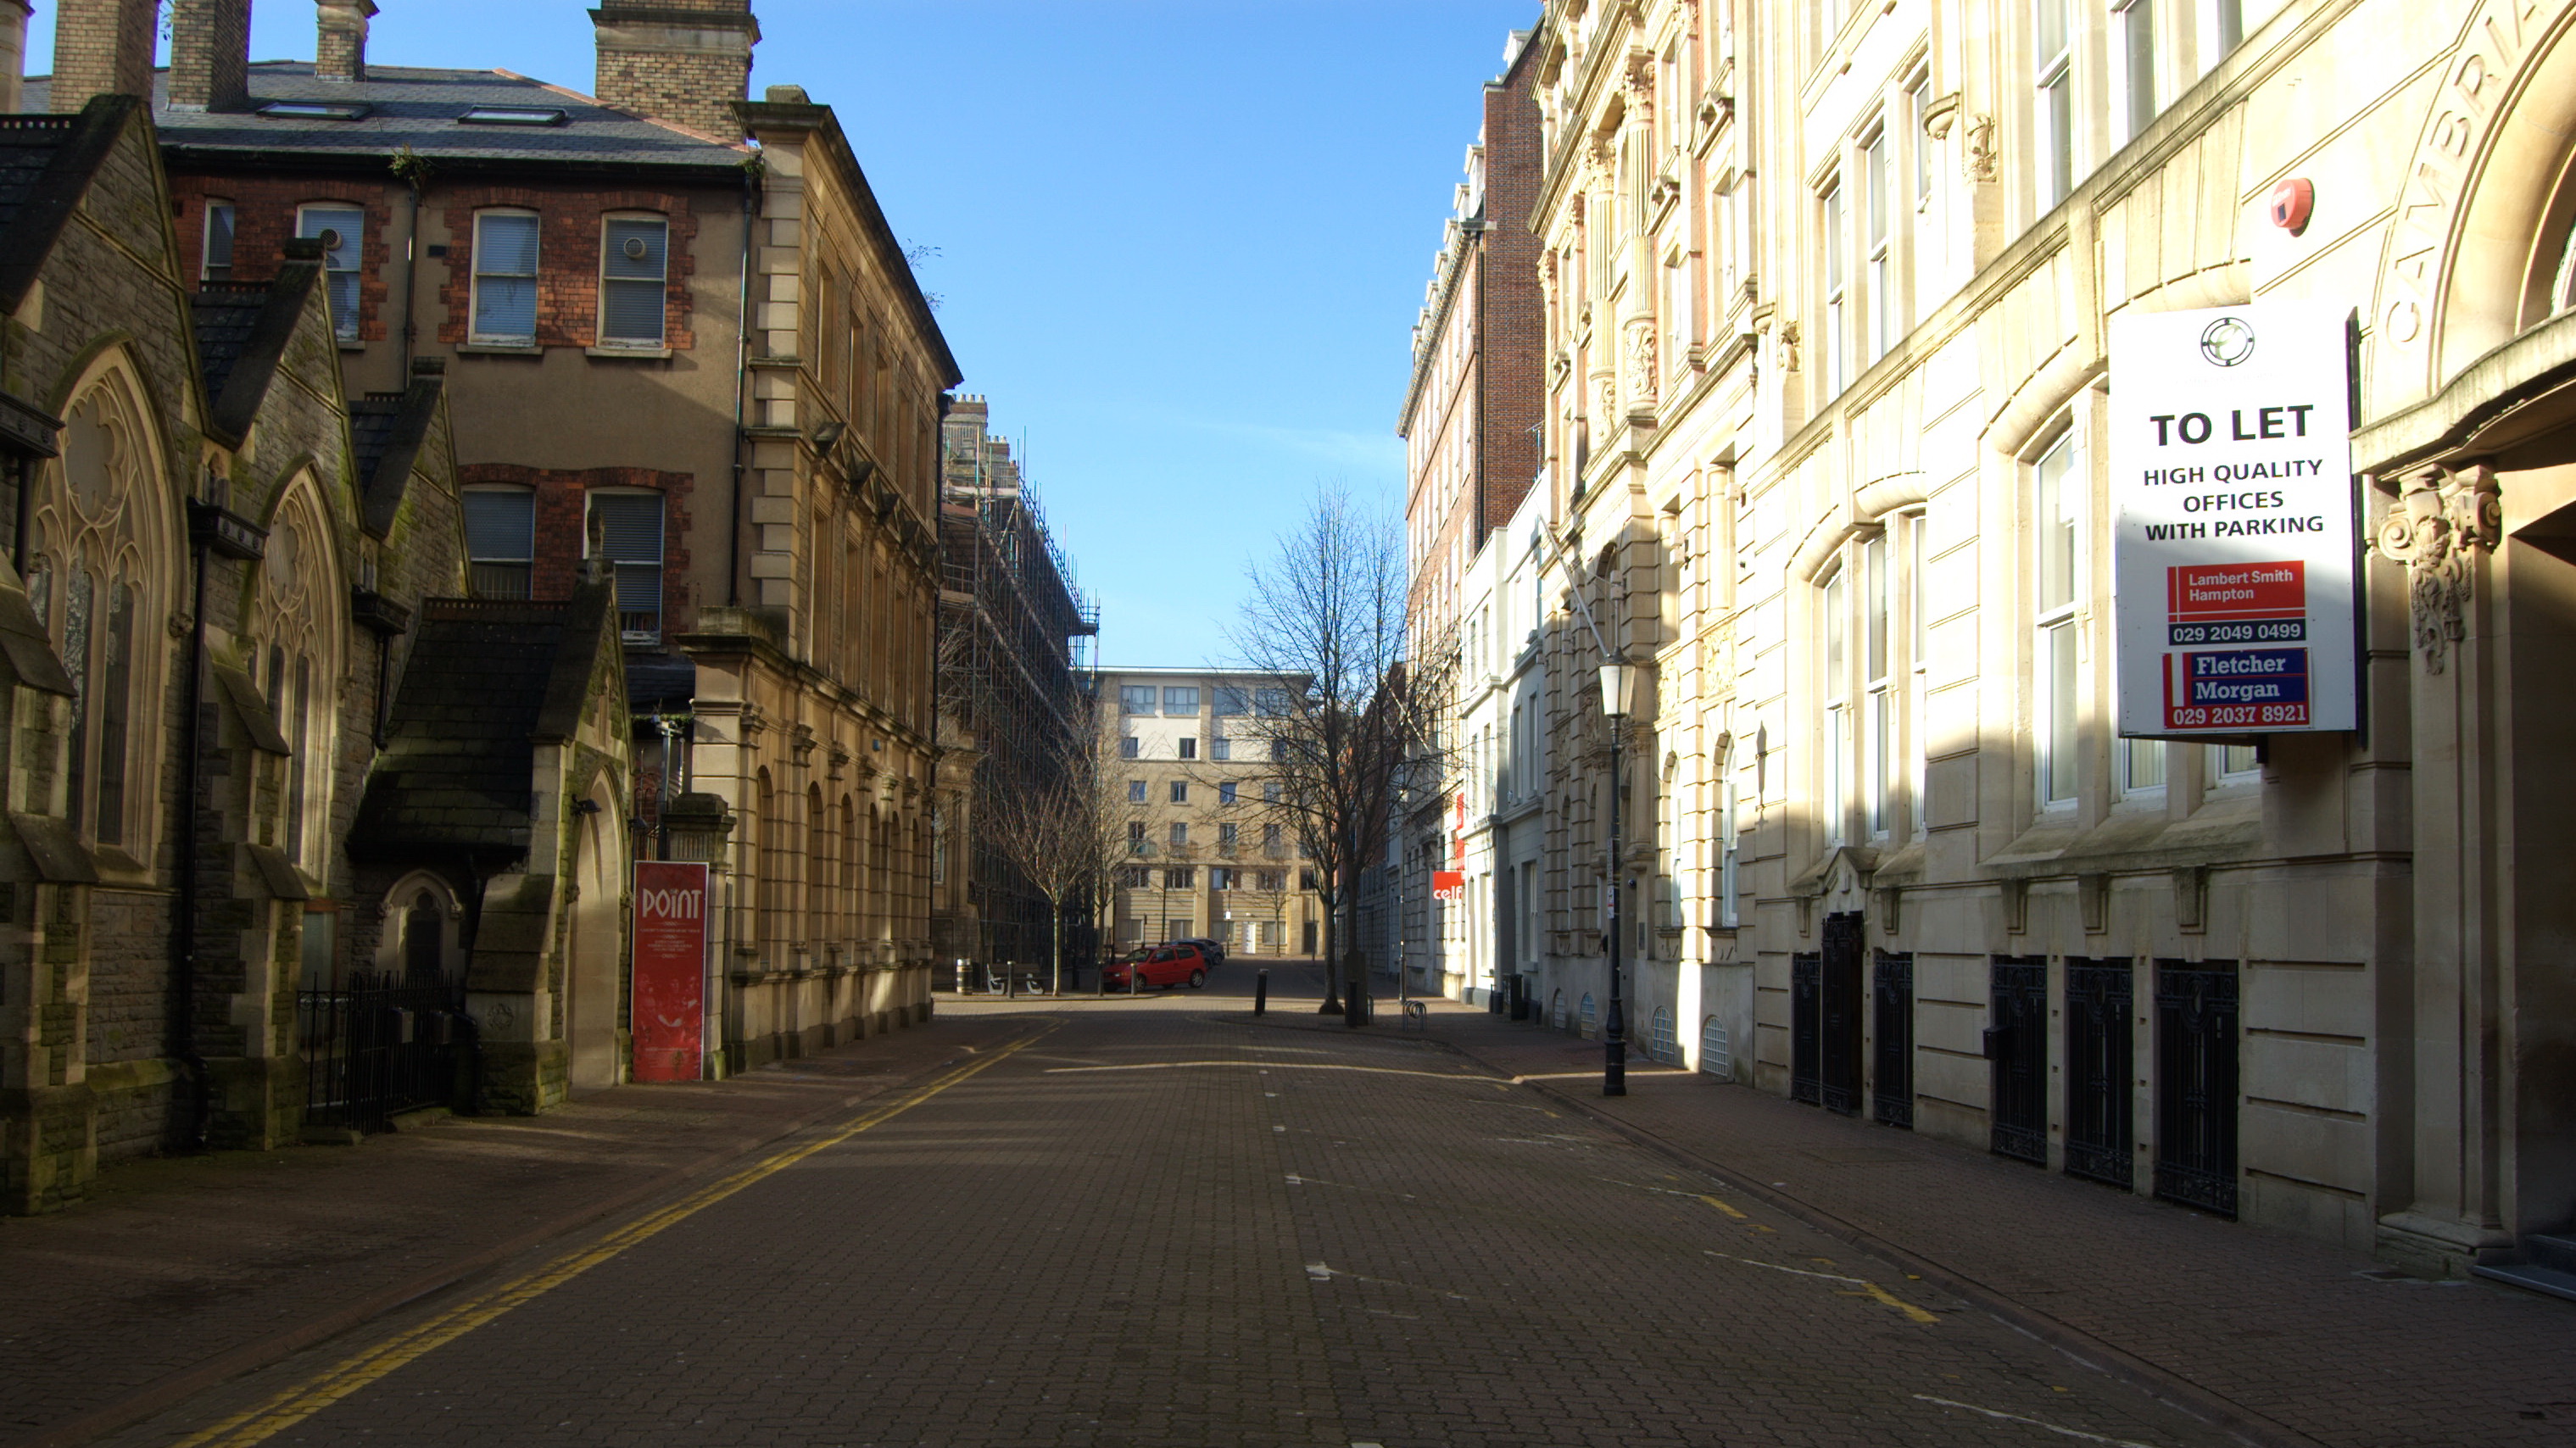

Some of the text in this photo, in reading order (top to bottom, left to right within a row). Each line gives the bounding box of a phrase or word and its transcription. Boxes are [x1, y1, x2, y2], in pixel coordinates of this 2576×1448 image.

[2149, 404, 2314, 447] TO LET
[2144, 459, 2323, 486] HIGH QUALITY
[2183, 491, 2283, 513] OFFICES
[2144, 515, 2323, 541] WITH PARKING
[2188, 569, 2294, 586] Lambert Smith
[2189, 588, 2255, 603] Hampton
[2173, 623, 2301, 643] 029 2049 0499
[2196, 654, 2287, 675] Fletcher
[2195, 682, 2280, 702] Morgan
[2172, 705, 2306, 726] 029 2037 8921
[1433, 885, 1463, 900] celf
